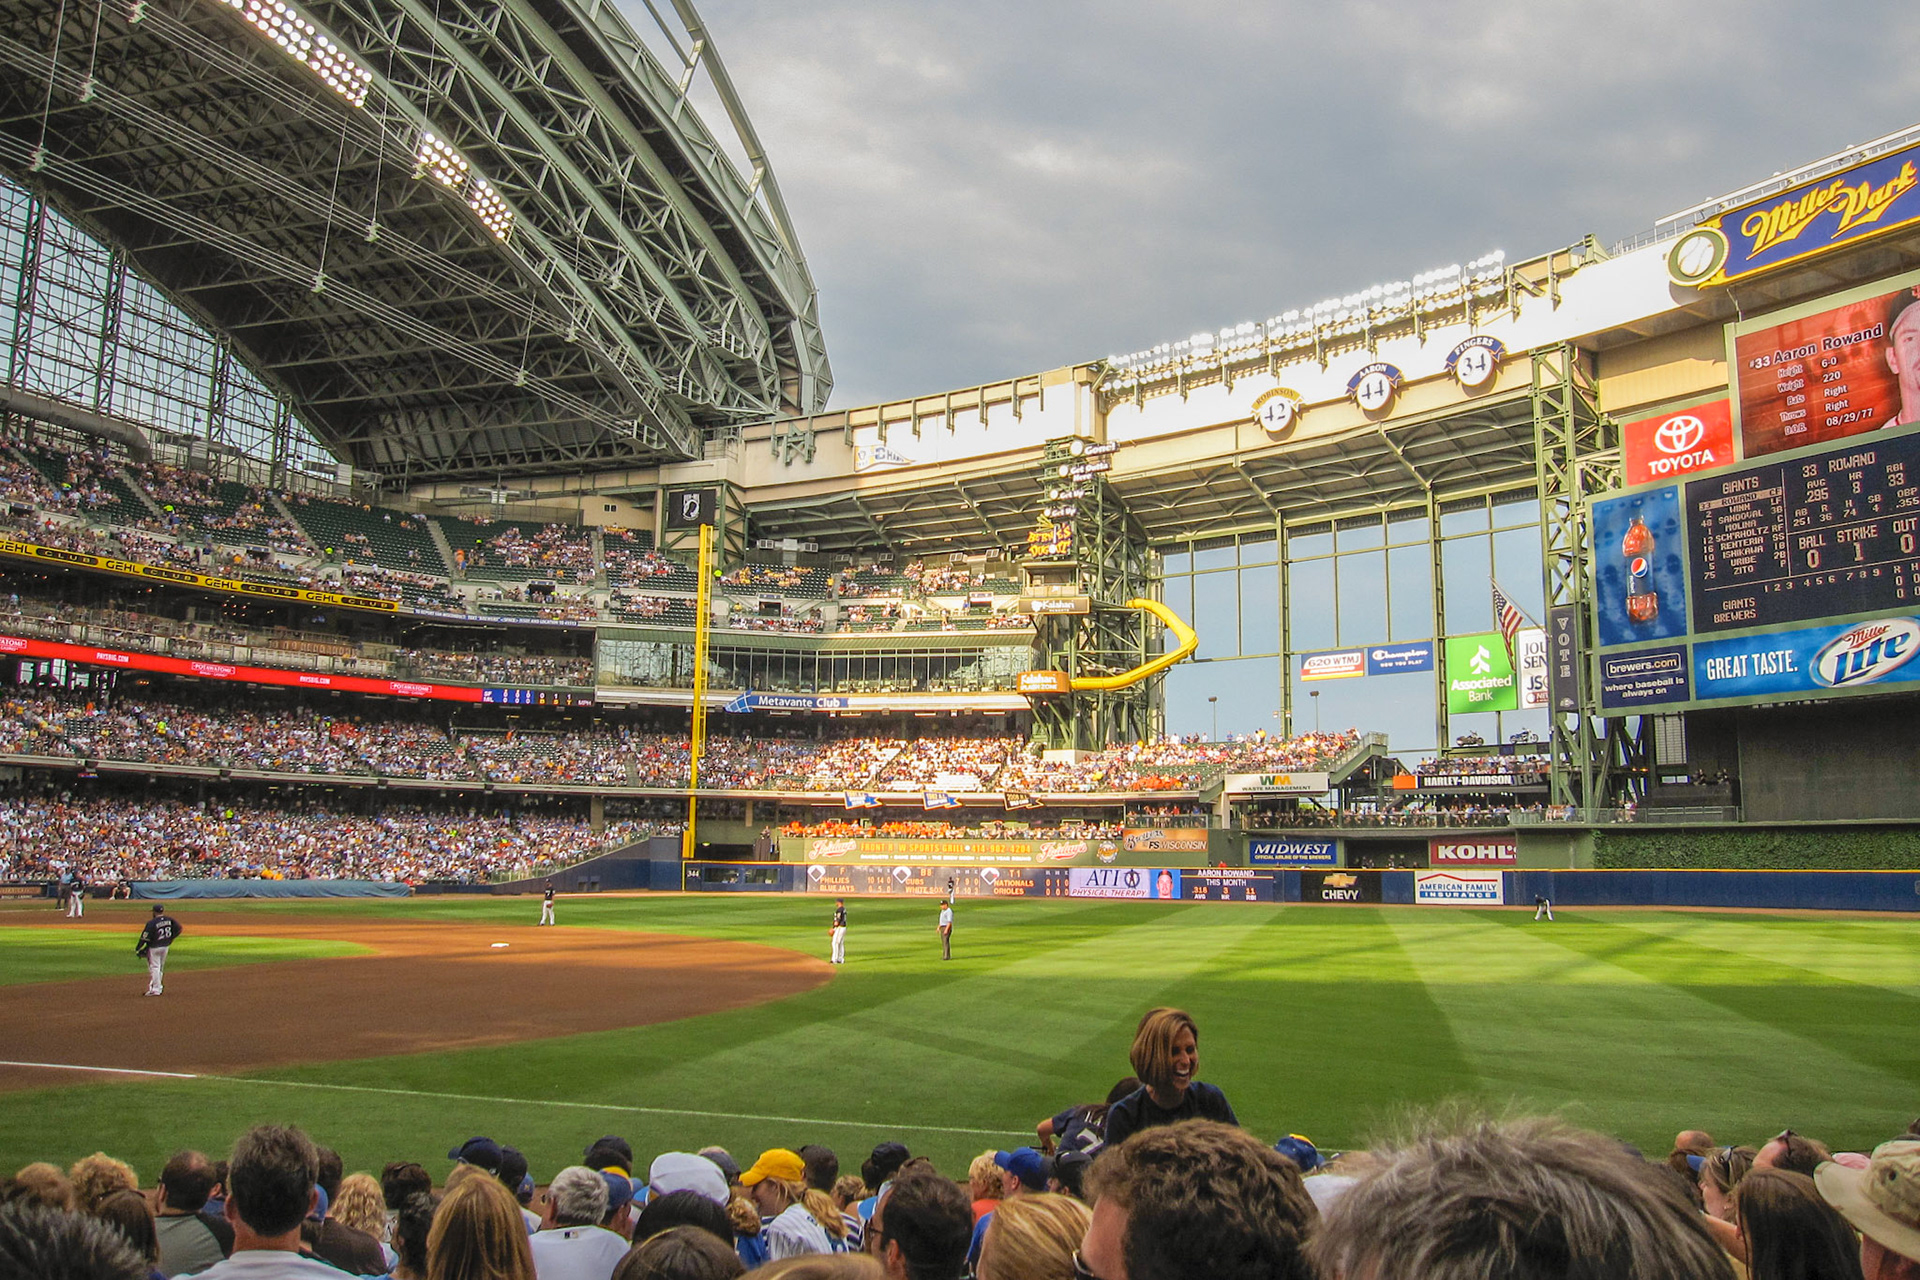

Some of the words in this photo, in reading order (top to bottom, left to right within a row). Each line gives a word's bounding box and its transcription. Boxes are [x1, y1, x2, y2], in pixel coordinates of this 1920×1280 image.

[1741, 179, 1845, 254] Miller
[1828, 160, 1918, 236] Park
[1455, 337, 1494, 356] FINGERS
[1749, 355, 1771, 369] #33
[1773, 343, 1818, 365] Aaron
[1822, 323, 1883, 351] Rowand
[1360, 364, 1387, 378] AARON
[1462, 353, 1486, 376] 34
[1778, 364, 1803, 378] Height
[1821, 357, 1837, 368] 6-0
[1362, 379, 1384, 399] 44
[1777, 379, 1804, 393] Weight
[1822, 371, 1841, 383] 220
[1256, 388, 1294, 405] ROBINSON
[1787, 394, 1805, 406] Bats
[1824, 385, 1848, 398] Right
[1264, 402, 1286, 421] 42
[1779, 409, 1806, 422] Throws
[1825, 399, 1849, 412] Right
[1826, 408, 1873, 427] 08/29/77
[1648, 449, 1714, 475] TOYOTA
[1802, 464, 1818, 478] 33
[1828, 452, 1876, 473] ROWAND
[1807, 479, 1826, 489] AVG
[1848, 471, 1863, 481] HR
[1886, 463, 1904, 473] RBI
[1722, 476, 1759, 494] GIANTS
[1804, 487, 1829, 503] .295
[1888, 472, 1905, 487] 33
[1721, 493, 1757, 506] ROWAND
[1770, 496, 1782, 505] LF
[1795, 508, 1808, 517] AB
[1867, 494, 1881, 504] SB
[1897, 487, 1918, 498] OBP
[1718, 509, 1764, 525] SANDOVAL
[1793, 517, 1811, 527] 251
[1819, 512, 1832, 522] 36
[1843, 508, 1857, 518] 74
[1725, 519, 1757, 532] MOLINA
[1798, 534, 1826, 550] BALL
[1836, 524, 1878, 543] STRIKE
[1893, 517, 1917, 534] OUT
[1703, 536, 1714, 545] 12
[1771, 523, 1784, 532] RF
[1720, 536, 1764, 550] RENTERIA
[1772, 533, 1785, 541] SS
[44, 550, 91, 563] CLUB
[1704, 554, 1714, 562] 10
[1722, 545, 1764, 559] ISHIKAWA
[1807, 549, 1820, 569] 0
[1900, 533, 1915, 554] 0
[1730, 555, 1757, 567] URIBE
[106, 560, 140, 574] GEHL
[150, 569, 192, 581] CLUB
[1704, 572, 1716, 580] 75
[1733, 565, 1754, 575] ZITO
[205, 577, 238, 590] GEHL
[248, 586, 292, 596] CLUB
[306, 591, 338, 603] GEHL
[348, 599, 388, 608] CLUB
[1042, 600, 1075, 610] Kalahari
[1722, 597, 1756, 611] GIANTS
[1713, 609, 1757, 623] BREWERS
[1841, 624, 1891, 648] Miller
[1372, 649, 1428, 661] Champion
[1557, 617, 1571, 678] VOTE
[1308, 658, 1331, 667] 620
[1333, 656, 1360, 666] WTMJ
[1609, 658, 1677, 674] brewers.com
[1706, 655, 1748, 681] GREAT
[1751, 650, 1798, 676] TASTE.
[1831, 632, 1911, 686] Lite
[1020, 673, 1057, 685] Kalahari
[1451, 674, 1512, 691] Associated
[1604, 680, 1633, 692] where
[1635, 677, 1674, 689] baseball
[1676, 677, 1685, 685] is
[1468, 690, 1494, 702] Bank
[1622, 687, 1654, 698] always
[1655, 687, 1667, 695] on
[758, 696, 813, 707] Metavante
[816, 697, 840, 708] Club
[1259, 775, 1292, 785] WM
[1424, 774, 1511, 786] HARLEY-DAVIDSON
[1510, 773, 1543, 786] DECK
[860, 843, 885, 852] FRONT
[909, 843, 940, 852] SPORTS
[942, 844, 964, 853] GRILL
[1161, 840, 1207, 850] WISCONSIN
[1254, 844, 1331, 854] MIDWEST
[686, 870, 699, 878] 344
[1086, 869, 1120, 886] ATI
[1197, 869, 1221, 877] AARON
[839, 884, 855, 892] JAYS
[905, 886, 928, 894] WHITE
[993, 887, 1025, 895] ORIOLES
[1072, 888, 1108, 897] PHYSICAL
[1111, 889, 1147, 897] THERAPY
[1246, 887, 1256, 895] 11
[1322, 889, 1359, 900] CHEVY
[158, 926, 172, 940] 28
